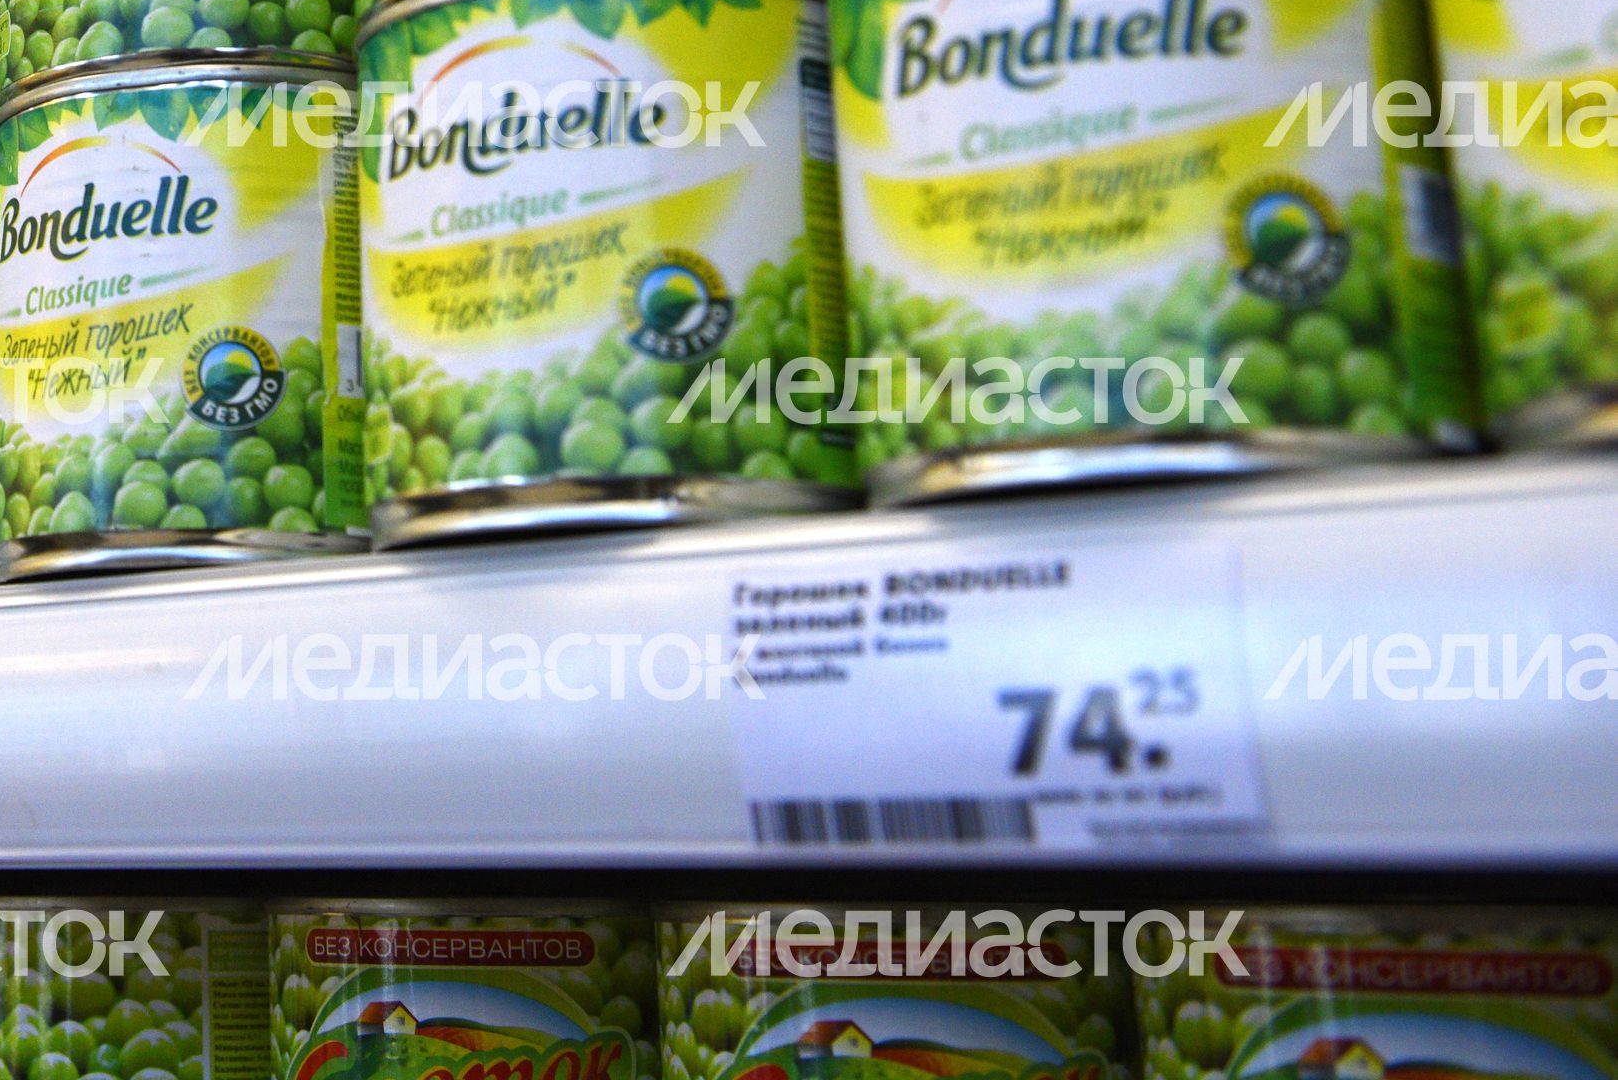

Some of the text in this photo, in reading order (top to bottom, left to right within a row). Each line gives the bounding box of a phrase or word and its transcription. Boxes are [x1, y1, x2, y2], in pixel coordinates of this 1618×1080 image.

[387, 78, 668, 182] Bonduelle
[0, 174, 219, 266] Bonduelle
[25, 272, 133, 317] Classique
[1, 302, 195, 367] Зеленый горошек
[200, 377, 280, 424] БЕЗ ГМО
[312, 934, 583, 961] БЕЗ КОНСЕРВАНТОВ
